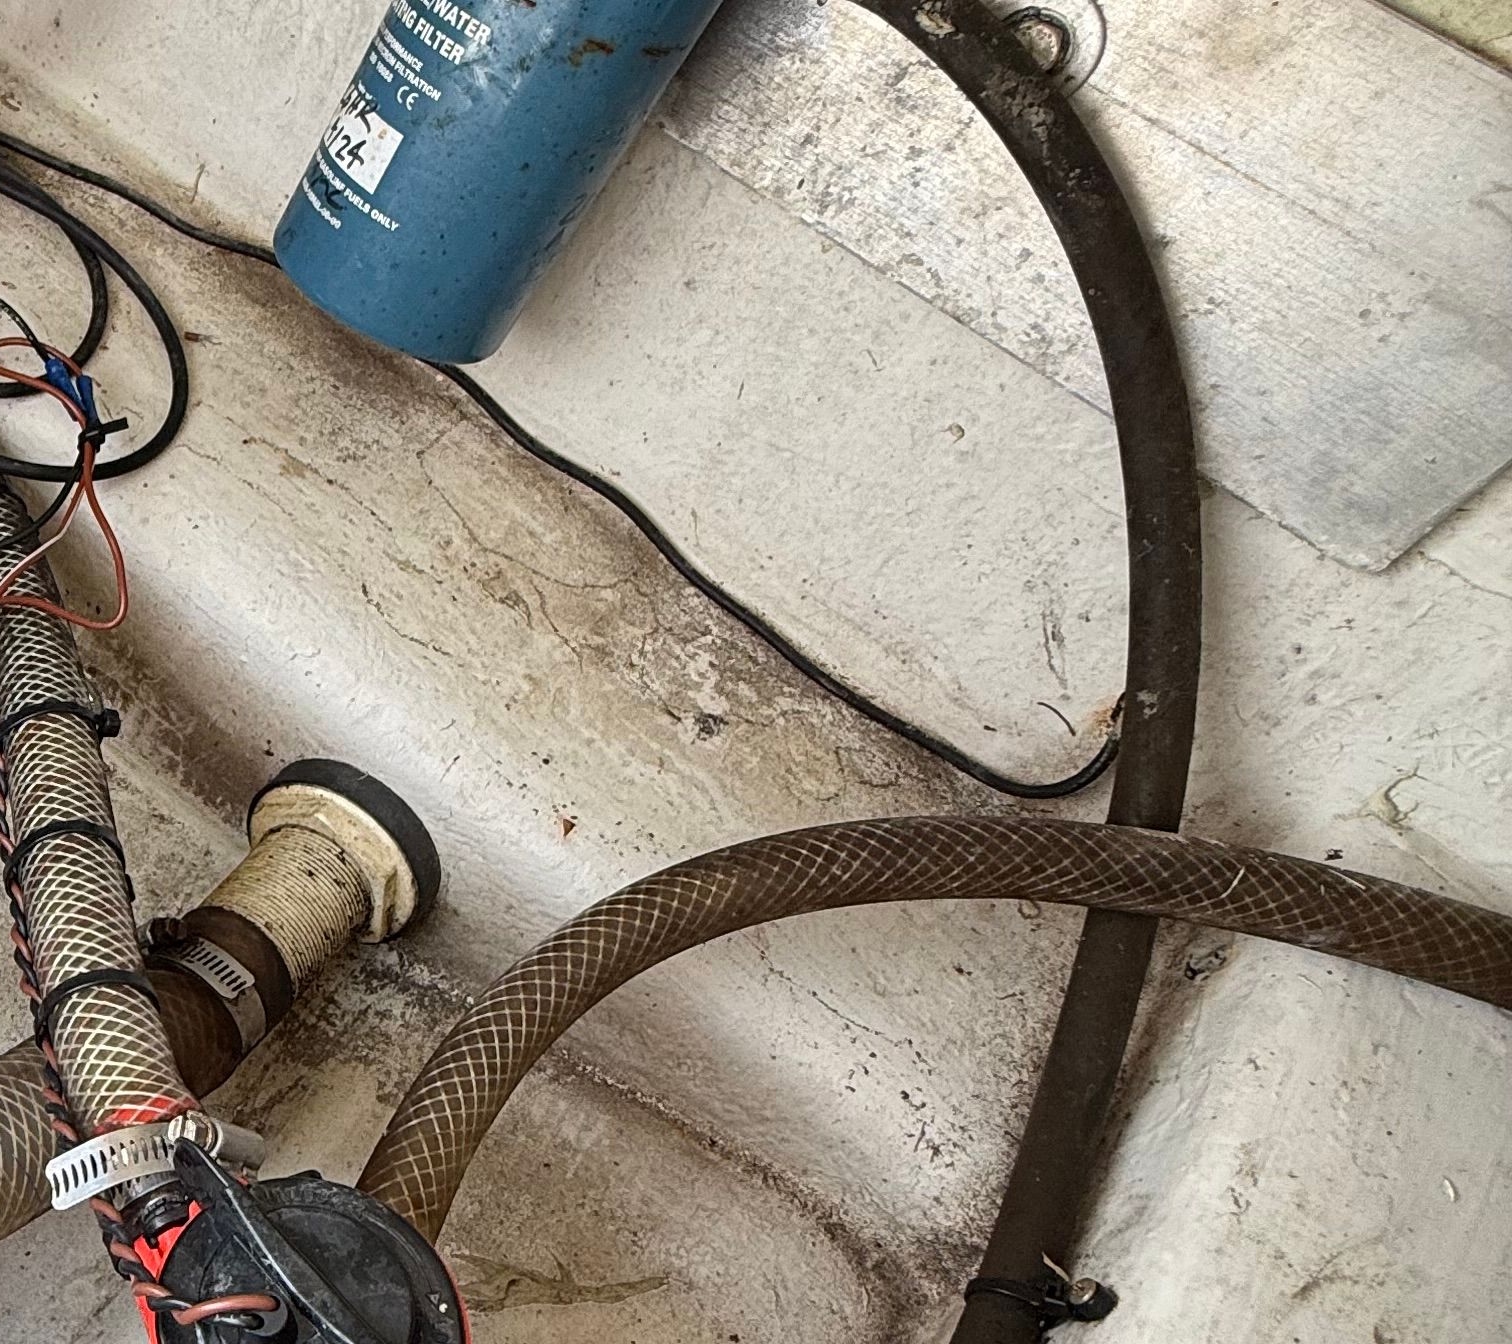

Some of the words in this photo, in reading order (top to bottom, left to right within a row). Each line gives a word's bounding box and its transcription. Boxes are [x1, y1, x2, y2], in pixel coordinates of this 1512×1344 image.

[410, 16, 467, 66] FILTER
[392, 60, 442, 102] FILTRATION
[394, 85, 419, 111] CE
[342, 187, 371, 213] FUELS
[369, 207, 399, 232] ONLY
